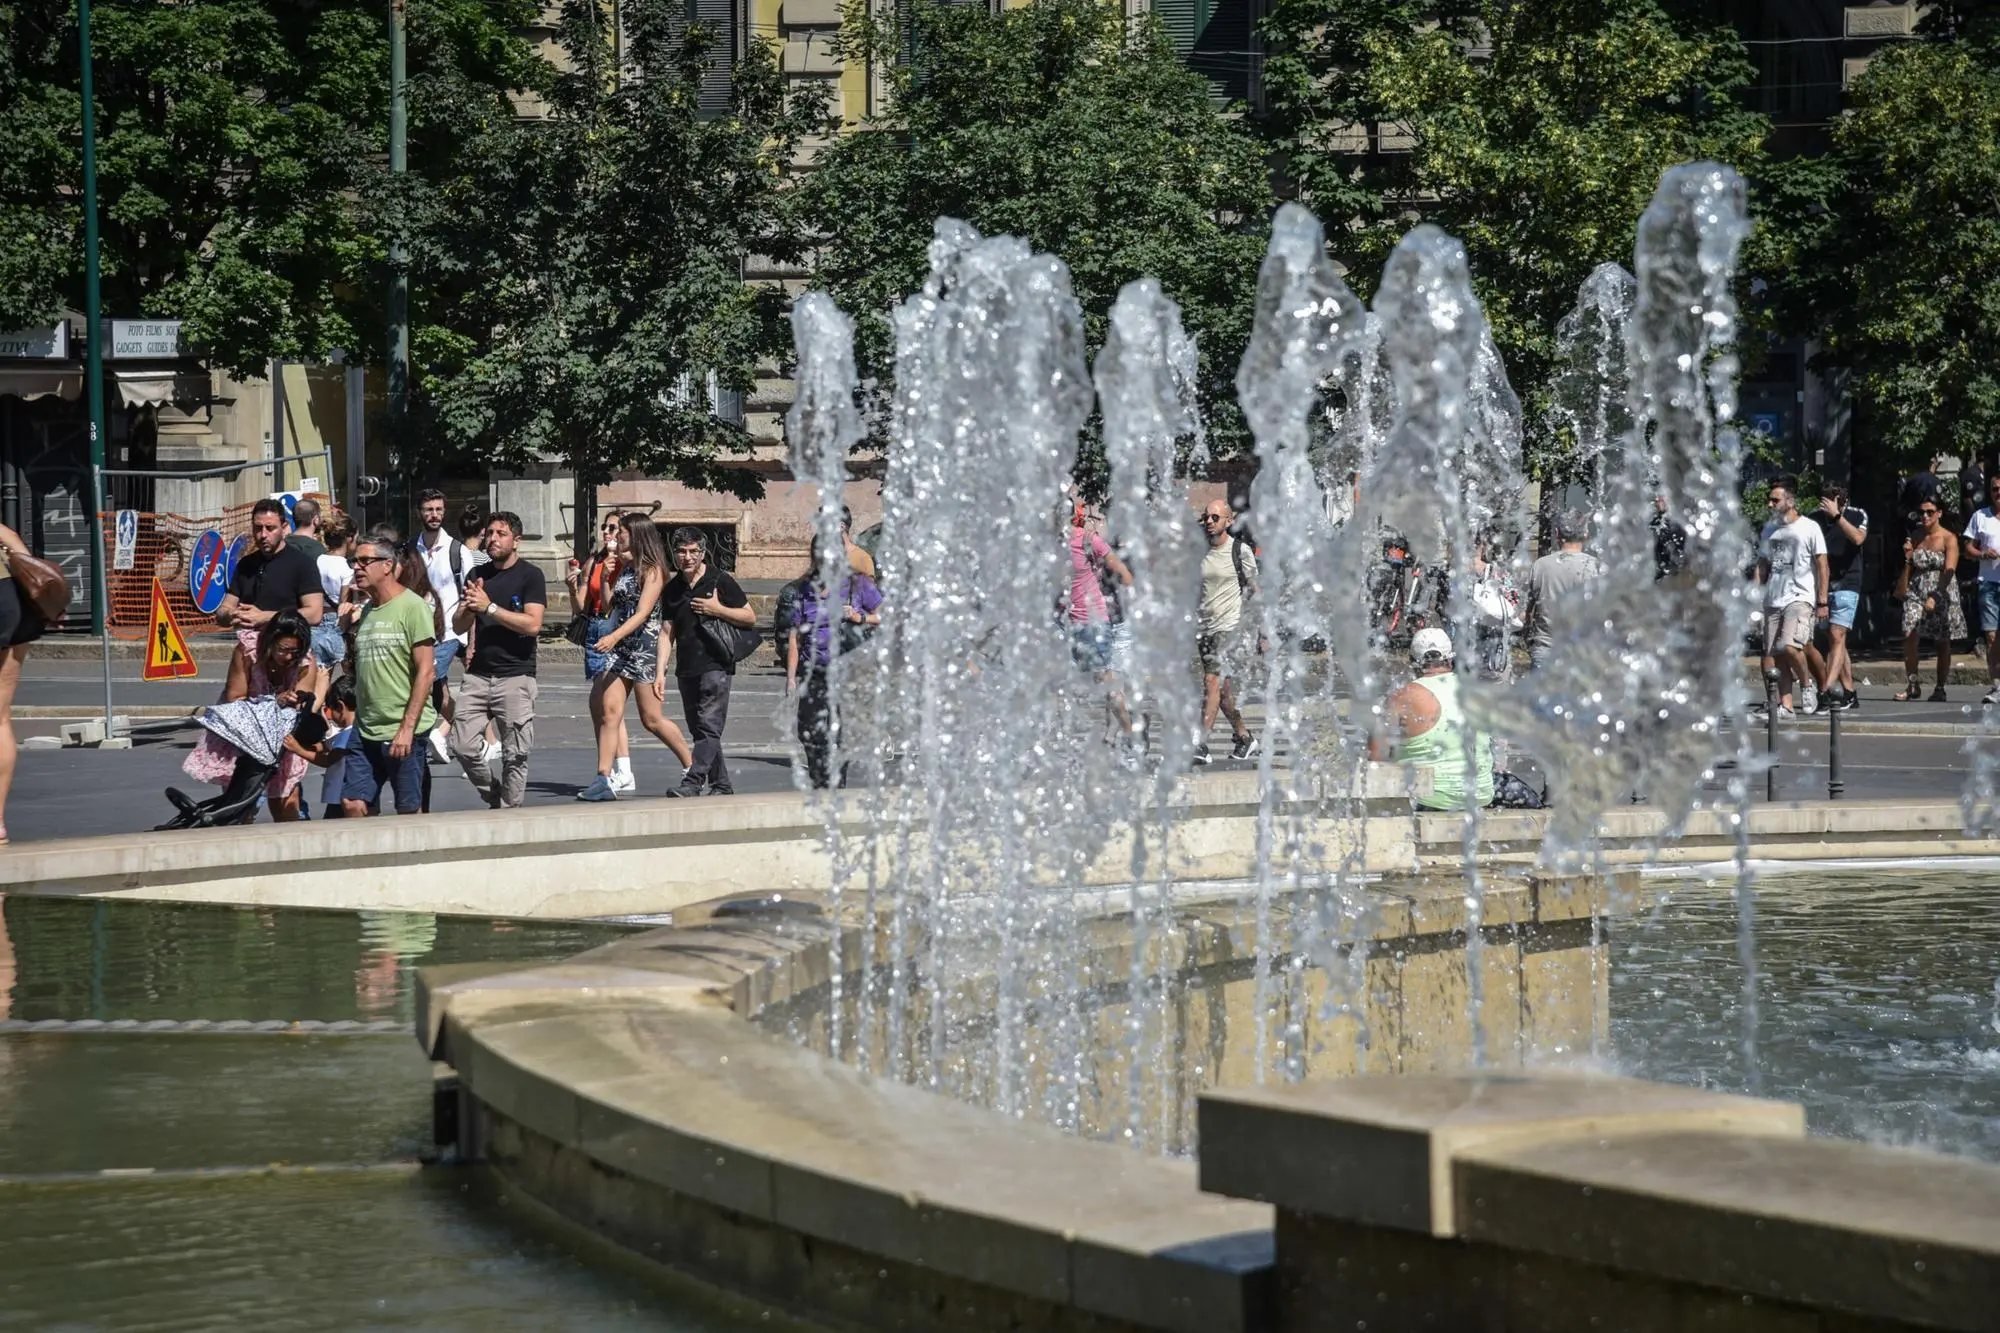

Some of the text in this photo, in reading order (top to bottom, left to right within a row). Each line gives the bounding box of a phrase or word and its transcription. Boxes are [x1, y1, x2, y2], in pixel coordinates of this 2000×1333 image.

[128, 325, 144, 336] FOTO
[116, 342, 142, 353] GADGETS
[147, 342, 168, 353] GUIDES
